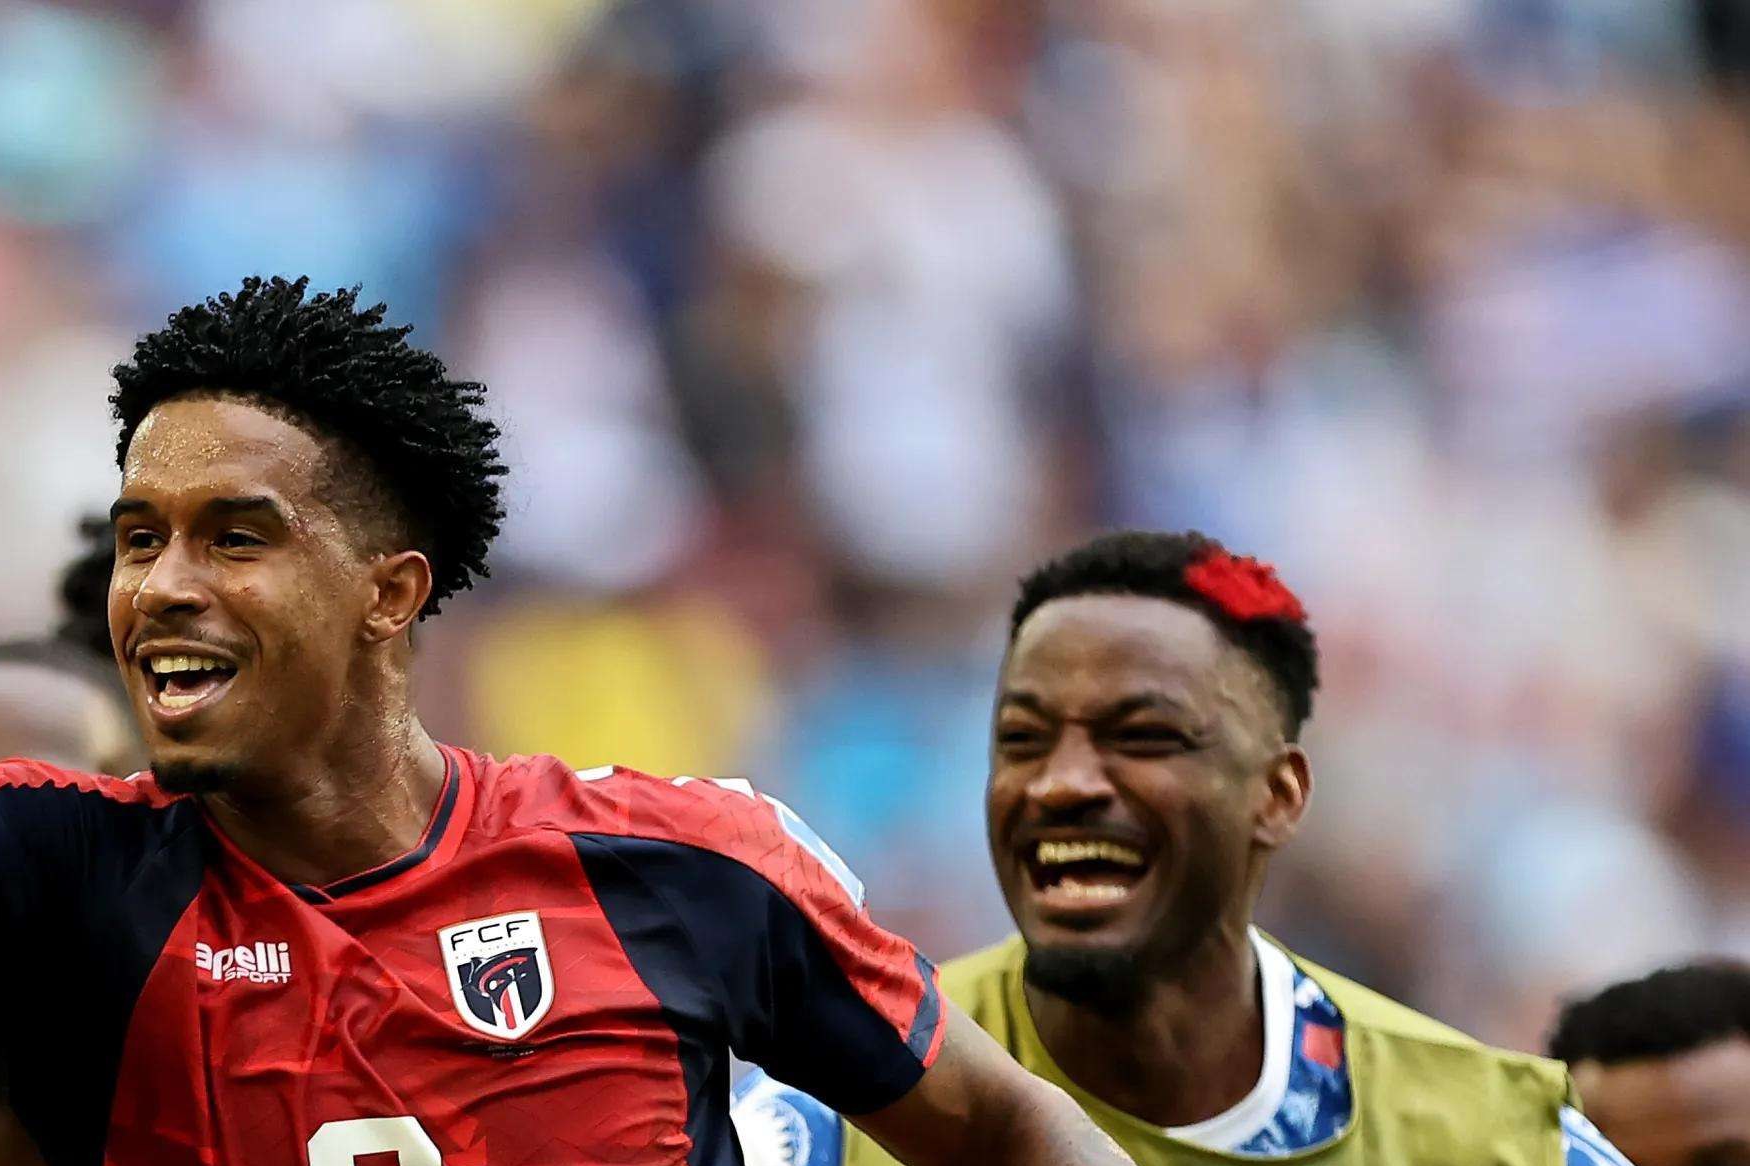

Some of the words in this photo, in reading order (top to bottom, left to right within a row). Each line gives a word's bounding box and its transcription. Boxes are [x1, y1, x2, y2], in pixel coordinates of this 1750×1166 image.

[450, 919, 530, 951] FCF
[195, 941, 291, 980] apelli
[224, 966, 292, 984] SPORT
